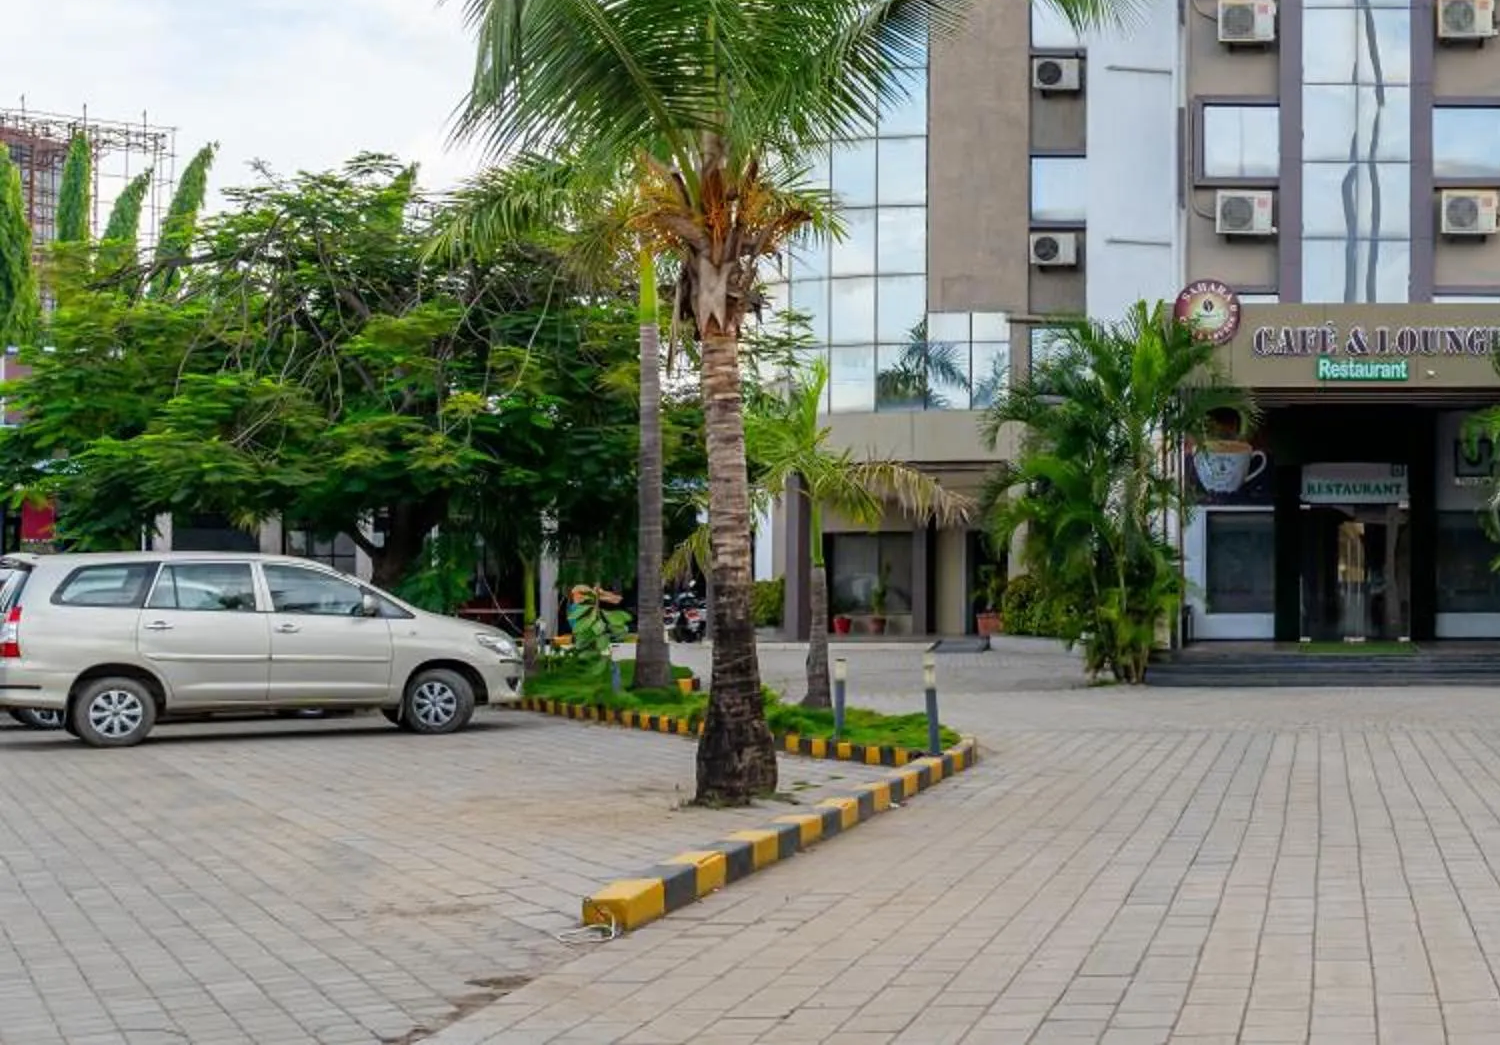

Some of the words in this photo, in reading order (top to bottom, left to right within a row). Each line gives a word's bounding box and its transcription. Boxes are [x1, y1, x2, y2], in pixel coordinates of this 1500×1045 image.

[1345, 326, 1371, 356] &
[1318, 358, 1408, 379] Restaurant
[1307, 482, 1403, 496] RESTAURANT
